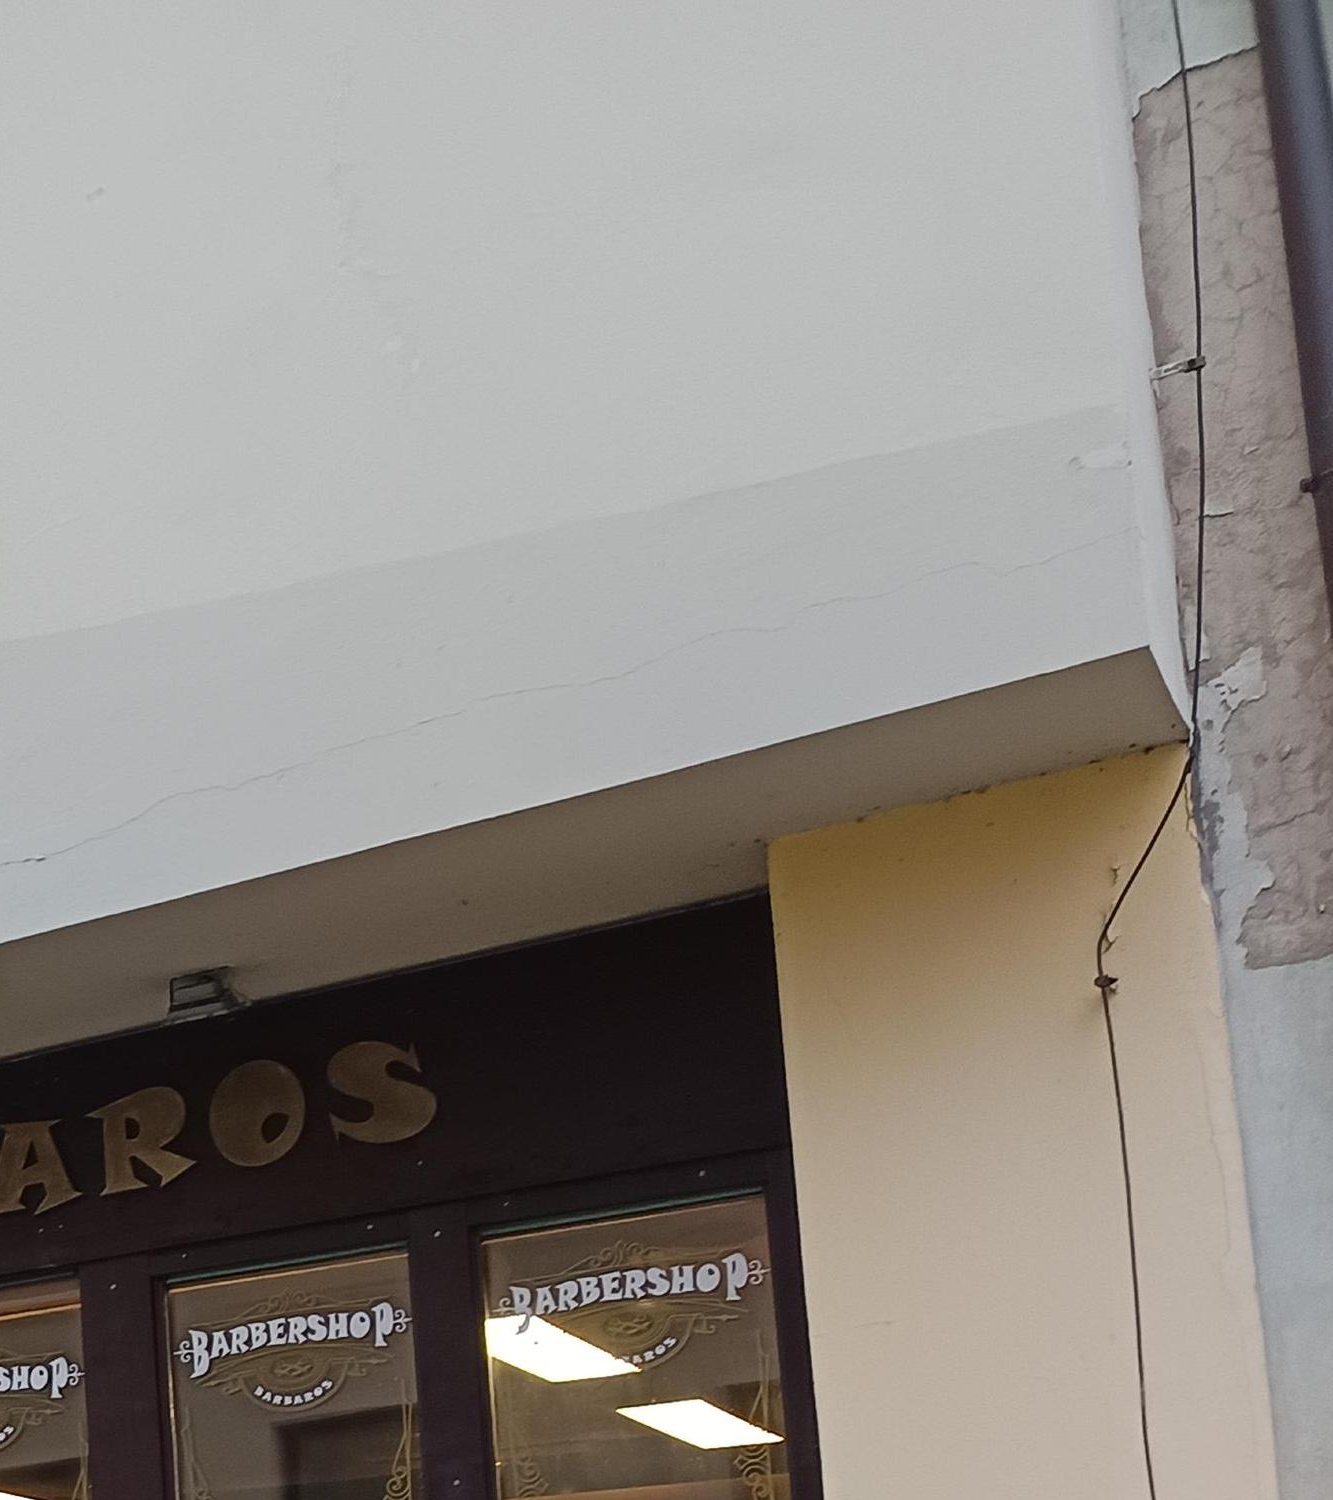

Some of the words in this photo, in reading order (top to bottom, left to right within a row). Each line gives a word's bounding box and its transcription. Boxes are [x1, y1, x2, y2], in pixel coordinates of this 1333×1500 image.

[509, 1253, 749, 1334] BARBERSHOP
[189, 1302, 394, 1379] BARBERSHOP
[253, 1379, 333, 1406] BARBAROS
